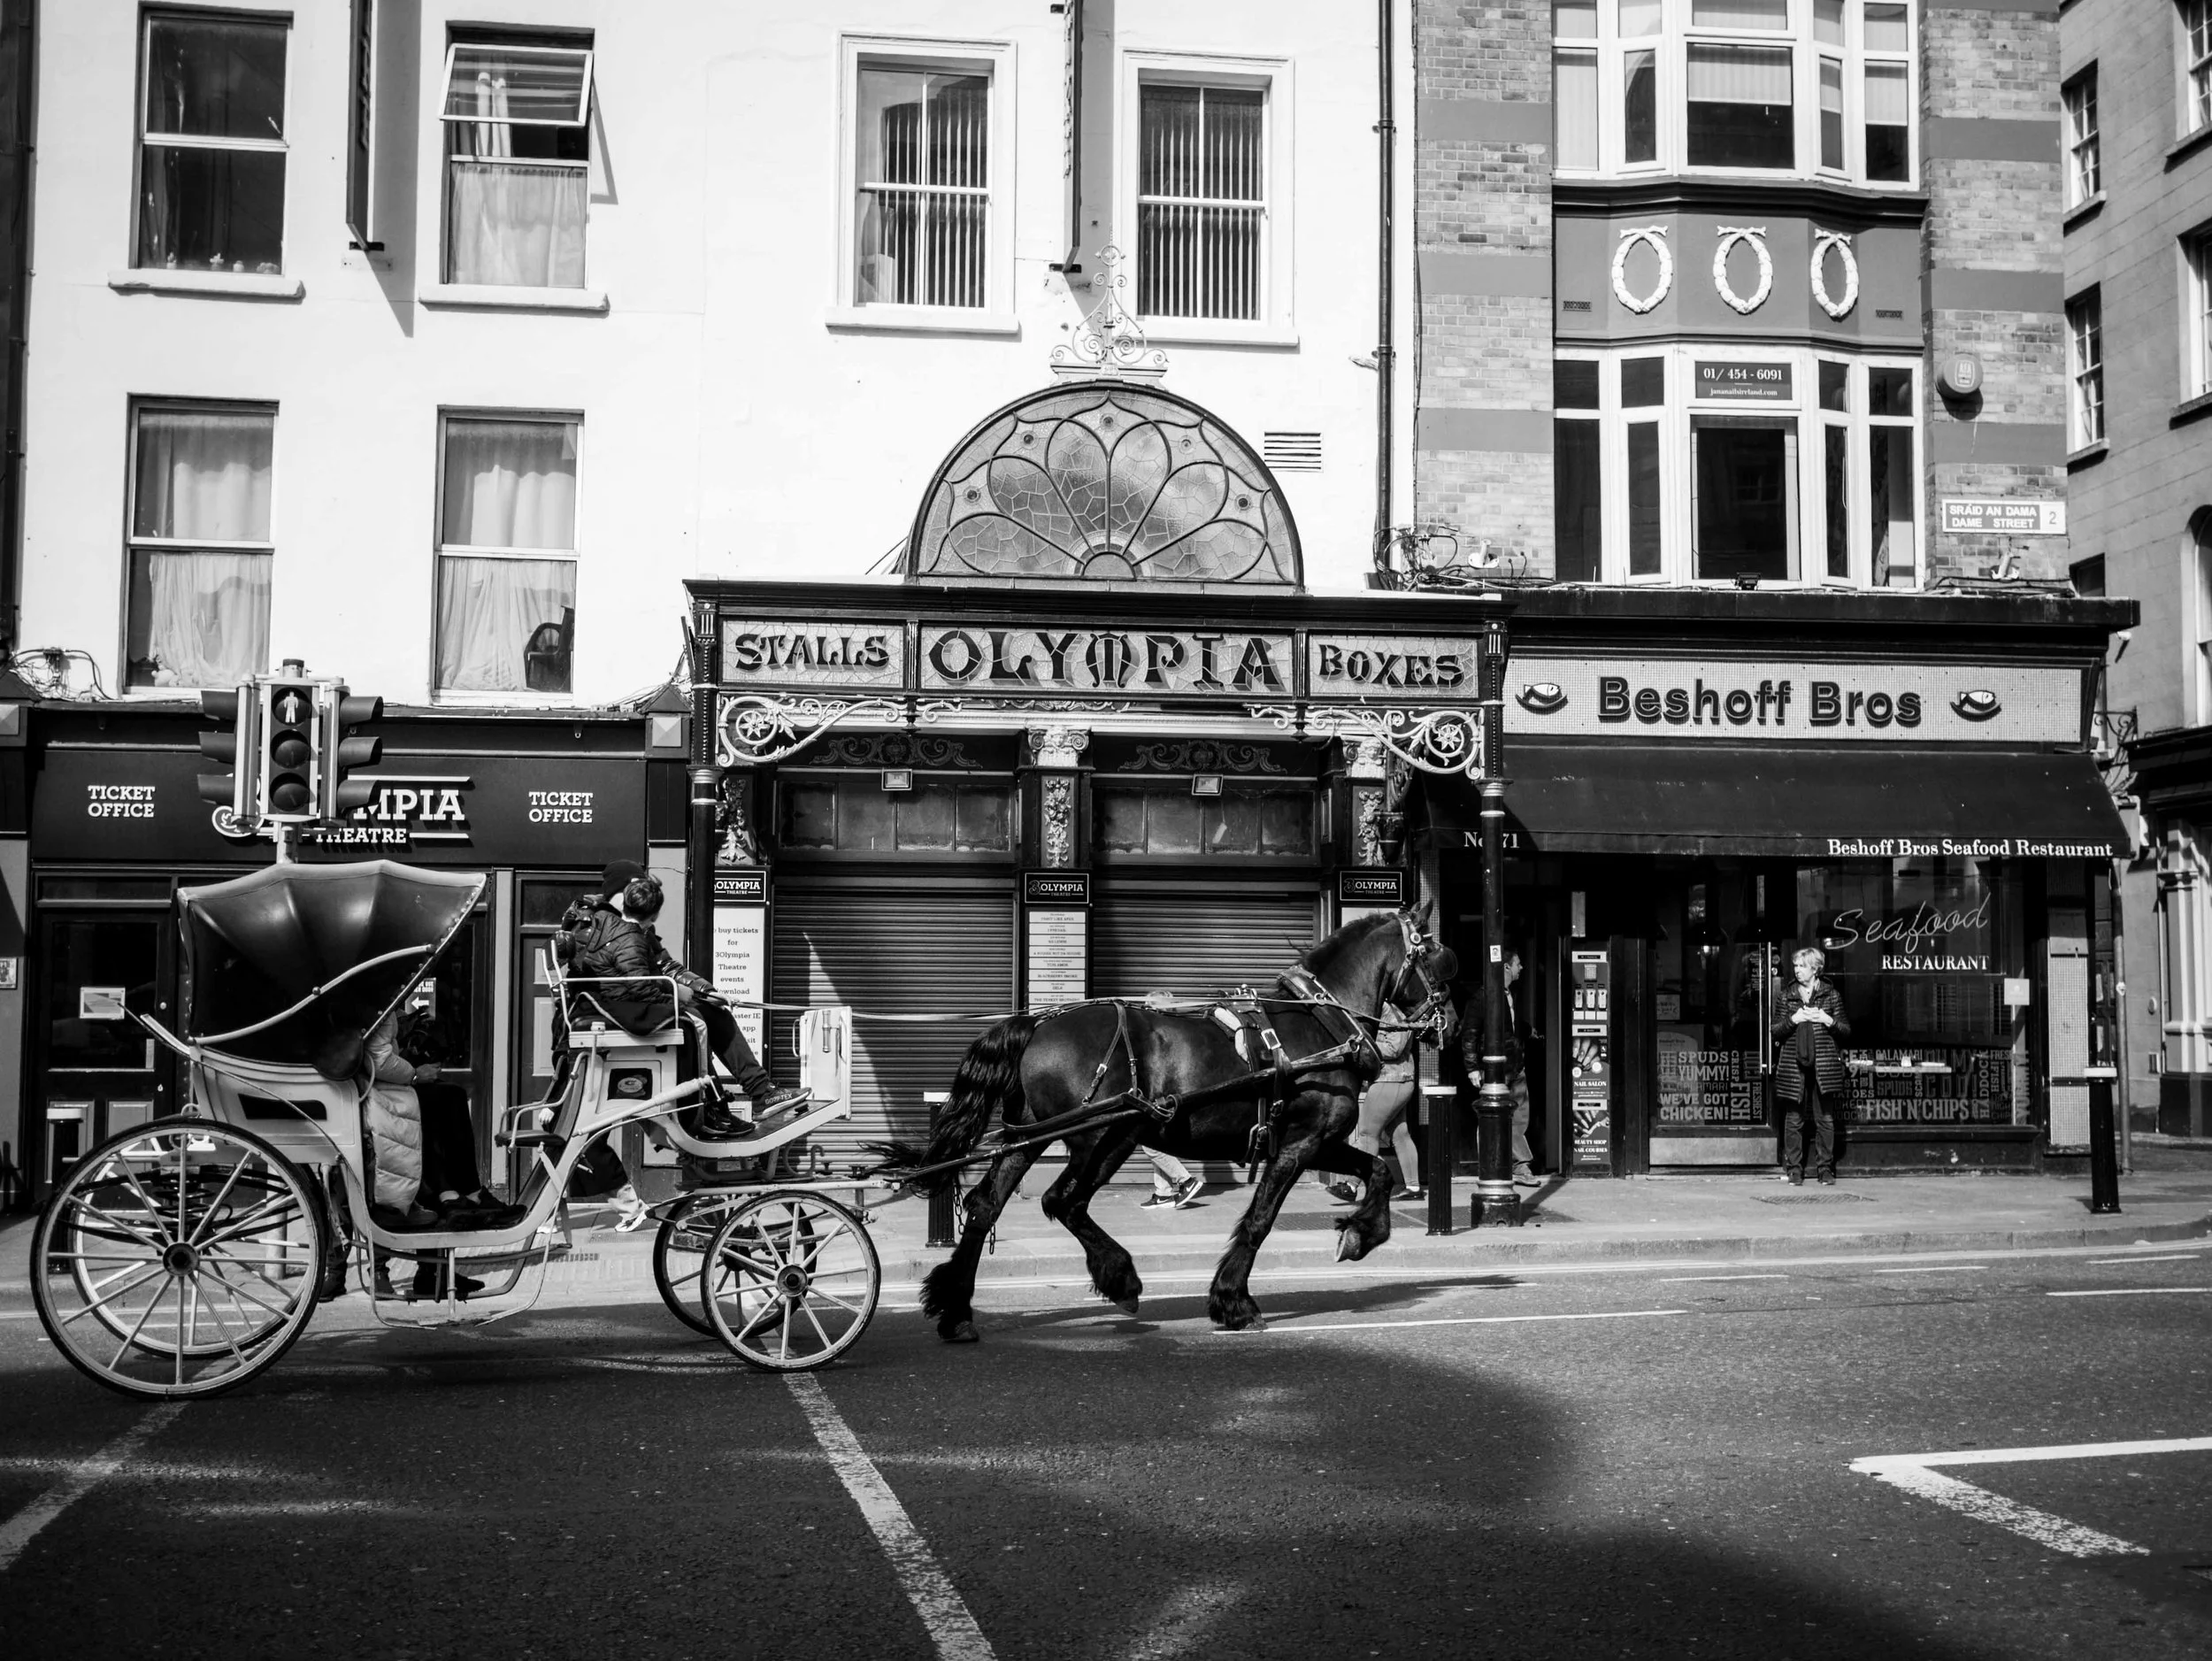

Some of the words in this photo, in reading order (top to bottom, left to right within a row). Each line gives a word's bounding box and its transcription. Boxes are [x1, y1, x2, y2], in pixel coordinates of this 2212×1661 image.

[1703, 367, 1724, 381] 01/
[1727, 368, 1747, 380] 454
[1756, 368, 1783, 381] 6091
[1949, 504, 1983, 516] SRÁID
[1985, 505, 2001, 516] AN
[2006, 506, 2037, 517] DAMA
[2048, 511, 2057, 525] 2
[1952, 518, 1983, 528] DAME
[1993, 519, 2034, 529] STREET
[735, 633, 890, 671] STALLS
[928, 630, 1286, 691] OLYMPIA
[1318, 644, 1467, 688] BOXES
[1598, 676, 1792, 727] Beshoff
[1809, 681, 1922, 728] Bros
[88, 785, 155, 800] TICKET
[528, 791, 594, 807] TICKET
[88, 803, 155, 817] OFFICE
[353, 788, 465, 820] MPIA
[528, 808, 594, 823] OFFICE
[1827, 838, 1894, 855] Beshoff
[1898, 839, 1939, 855] Bros
[1942, 839, 2011, 856] Seafood
[2016, 839, 2113, 856] Restaurant
[716, 880, 761, 890] OLYMPIA
[1041, 883, 1084, 892] OLYMPIA
[1355, 881, 1397, 890] OLYMPIA
[1824, 892, 1991, 954] Seafood
[1882, 955, 1990, 970] RESTAURANT
[1678, 1050, 1729, 1064] SPUDS
[1678, 1065, 1730, 1081] YUMMY!
[1731, 1050, 1740, 1082] CRISP
[1979, 1049, 1991, 1119] HADDOCK
[1659, 1092, 1700, 1105] WE'VE
[1703, 1093, 1730, 1105] GOT
[1730, 1082, 1751, 1120] FISH
[1660, 1106, 1730, 1120] CHICKEN!
